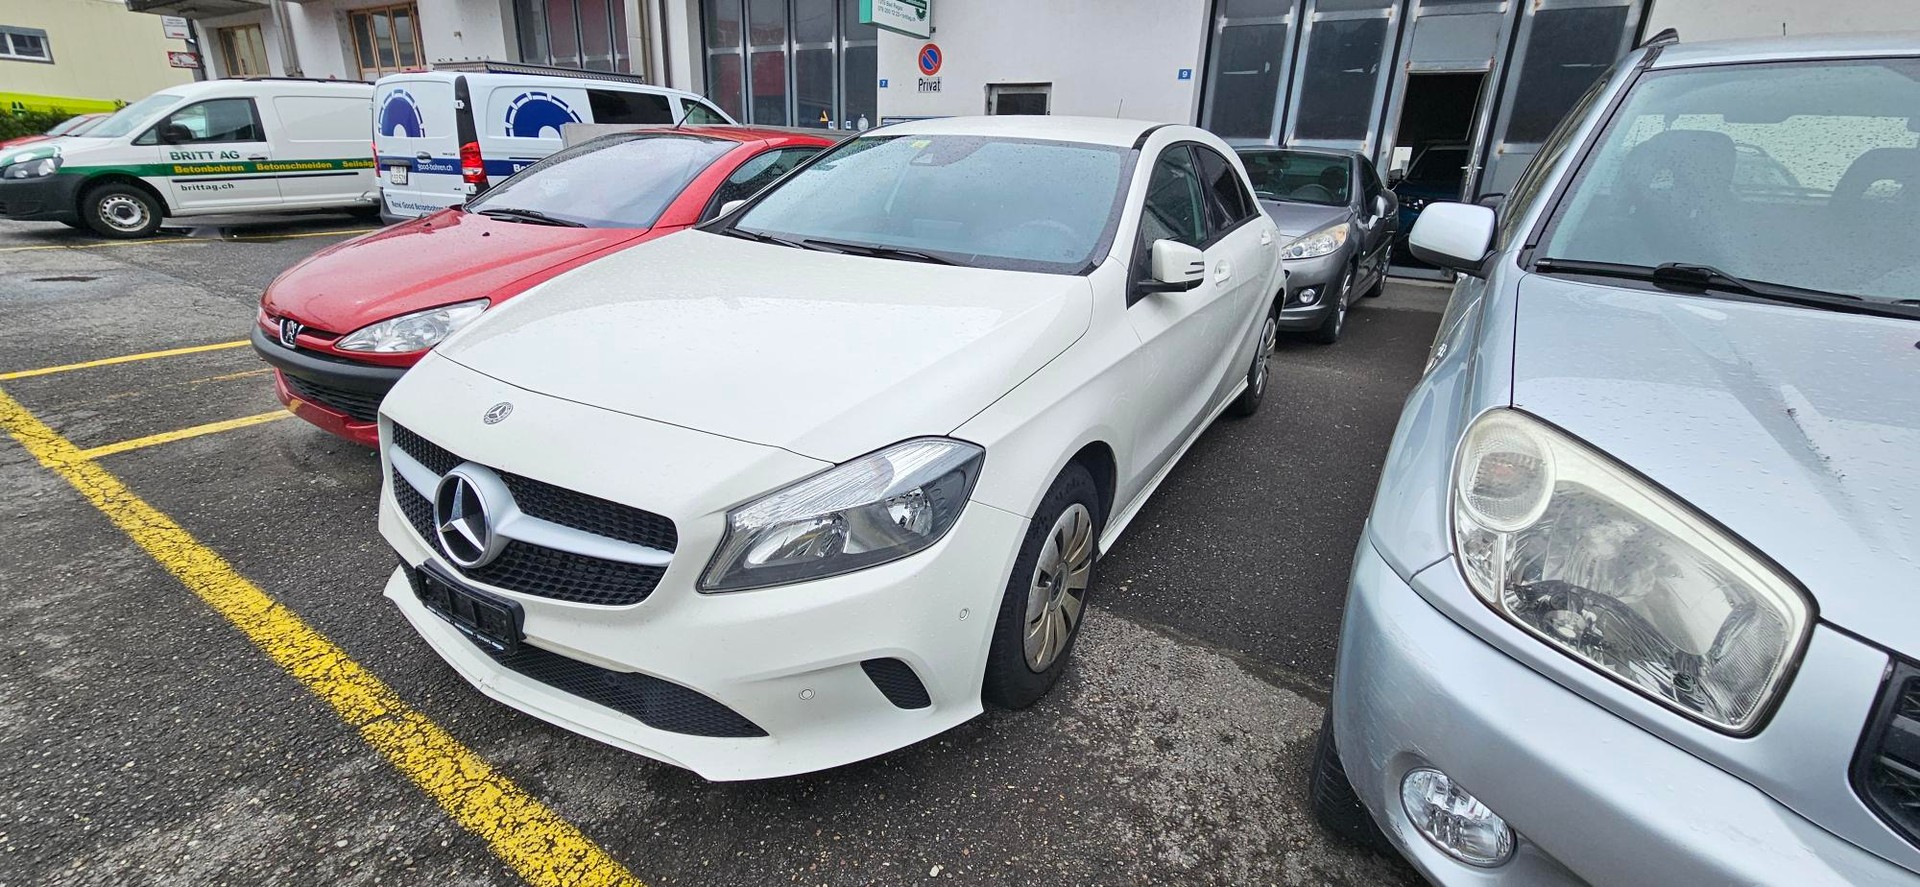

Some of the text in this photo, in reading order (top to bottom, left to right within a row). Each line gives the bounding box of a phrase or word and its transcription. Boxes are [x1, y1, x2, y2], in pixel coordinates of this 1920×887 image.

[1182, 70, 1188, 78] 9
[918, 78, 941, 92] Privat
[170, 150, 240, 161] BRITT AG
[174, 160, 376, 174] Betonbohren Betonschneiden Seilsäg
[417, 163, 453, 172] good-bohren.ch
[181, 182, 235, 192] brittag.ch
[402, 201, 414, 210] Good
